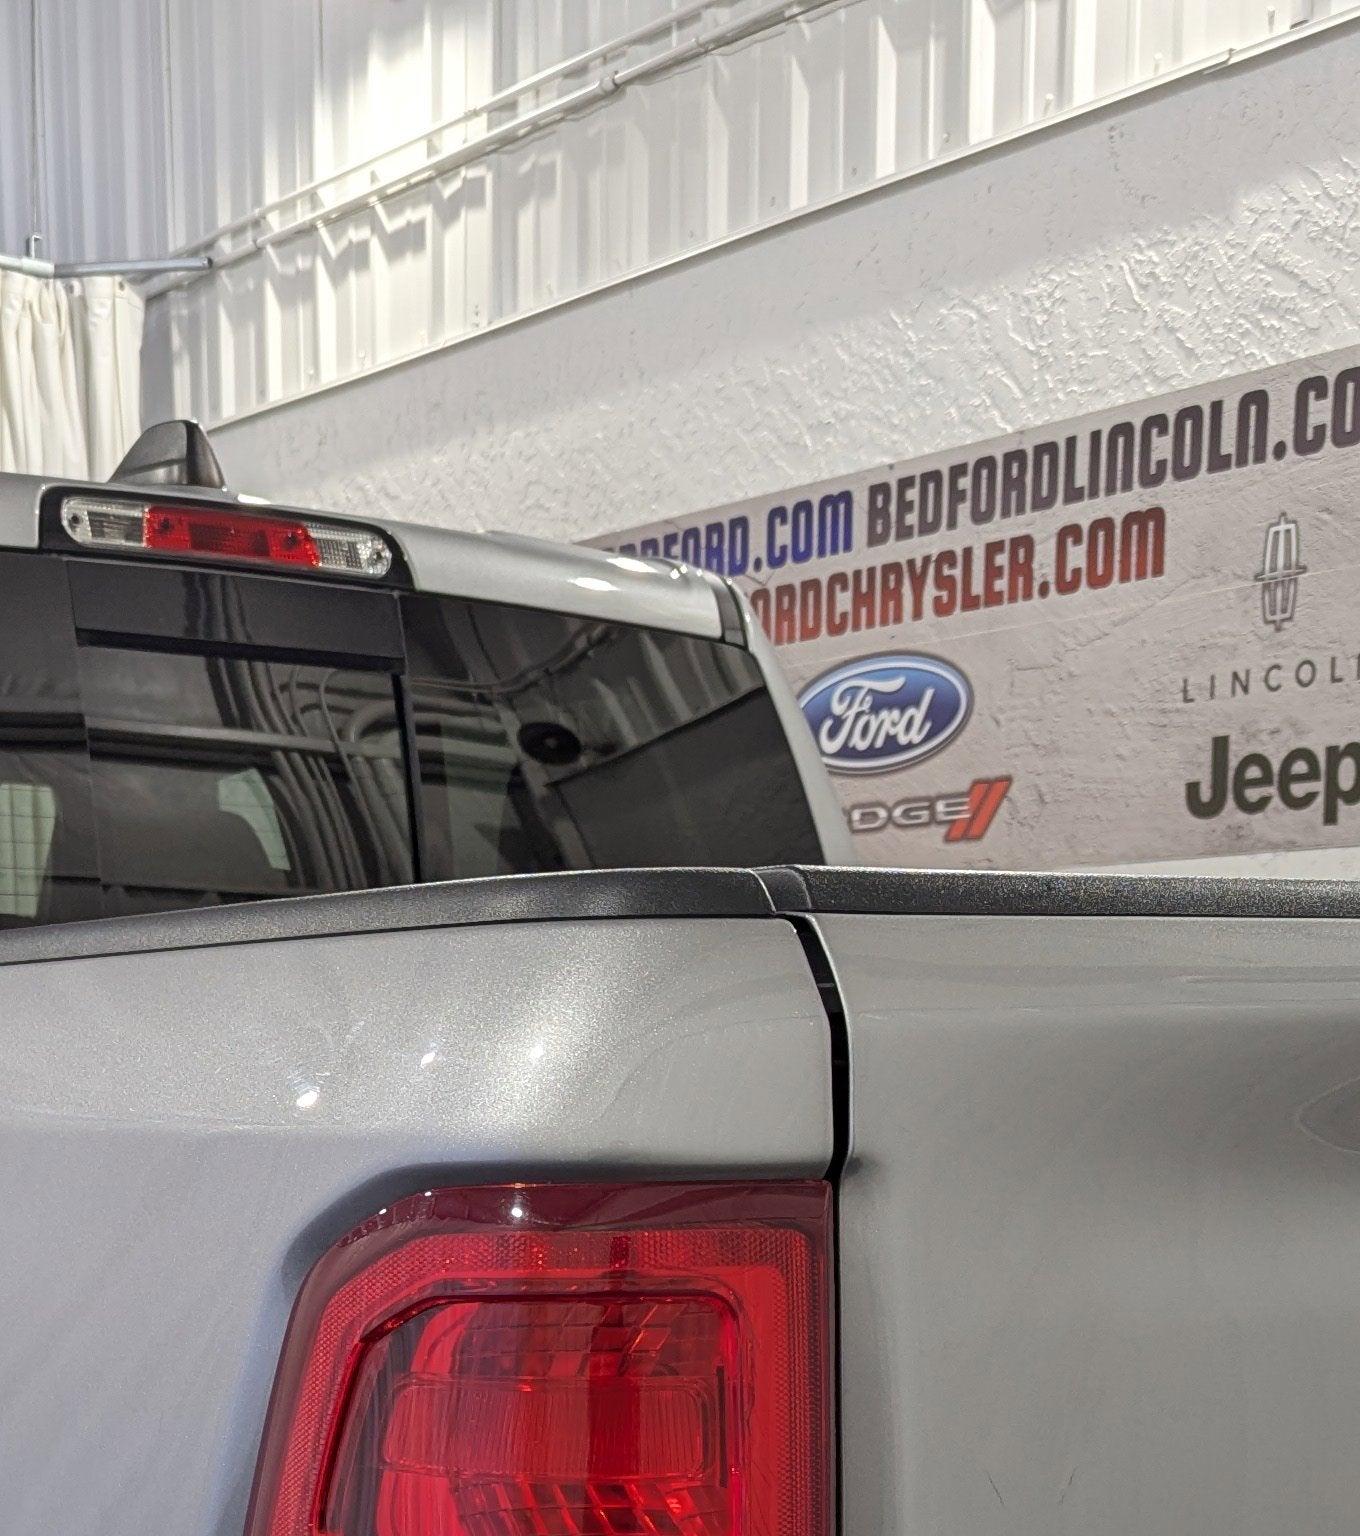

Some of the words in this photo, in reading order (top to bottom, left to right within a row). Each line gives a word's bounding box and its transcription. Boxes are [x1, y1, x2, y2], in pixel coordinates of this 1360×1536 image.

[602, 489, 854, 578] FORD.COM
[749, 505, 1167, 647] ORDCHRYSLER.COM
[818, 675, 936, 755] Ford
[846, 792, 973, 834] DGE
